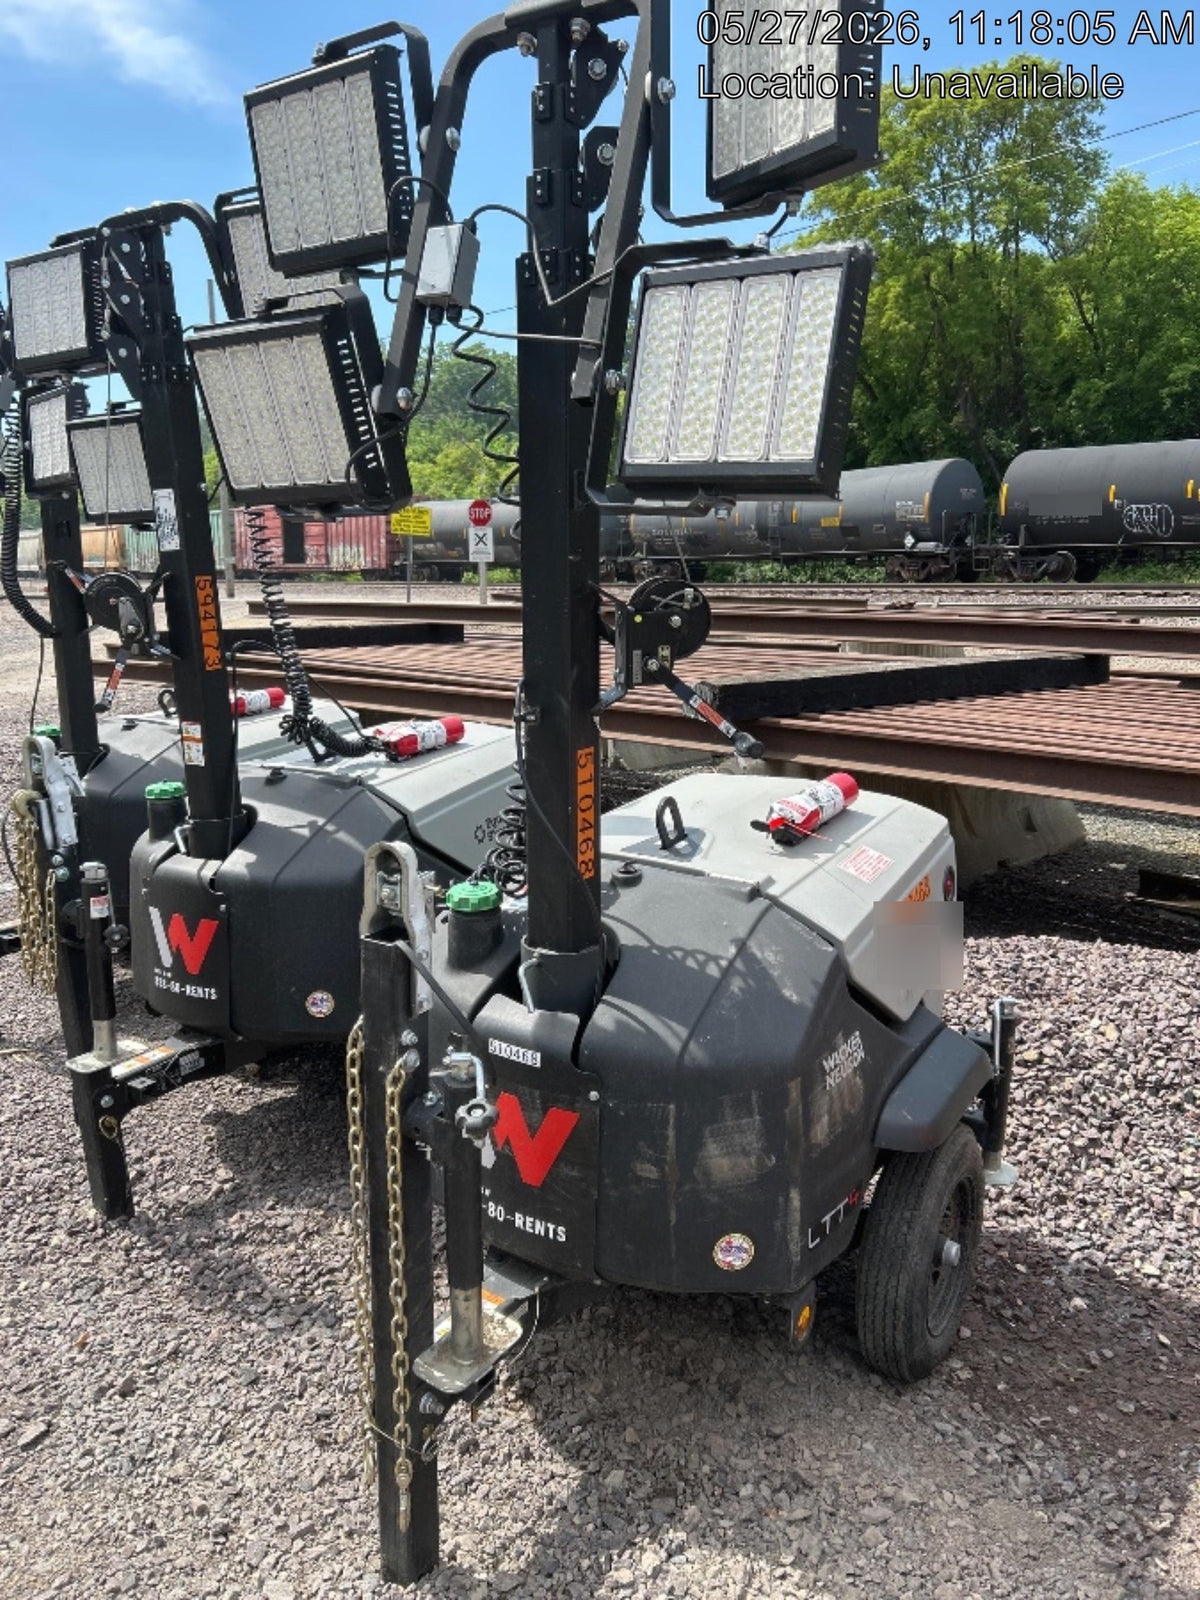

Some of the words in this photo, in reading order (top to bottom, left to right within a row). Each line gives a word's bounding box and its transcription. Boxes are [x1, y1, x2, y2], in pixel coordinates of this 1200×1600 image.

[469, 507, 491, 520] STOP
[576, 750, 595, 879] 510468
[481, 1201, 567, 1242] -80-RENTS
